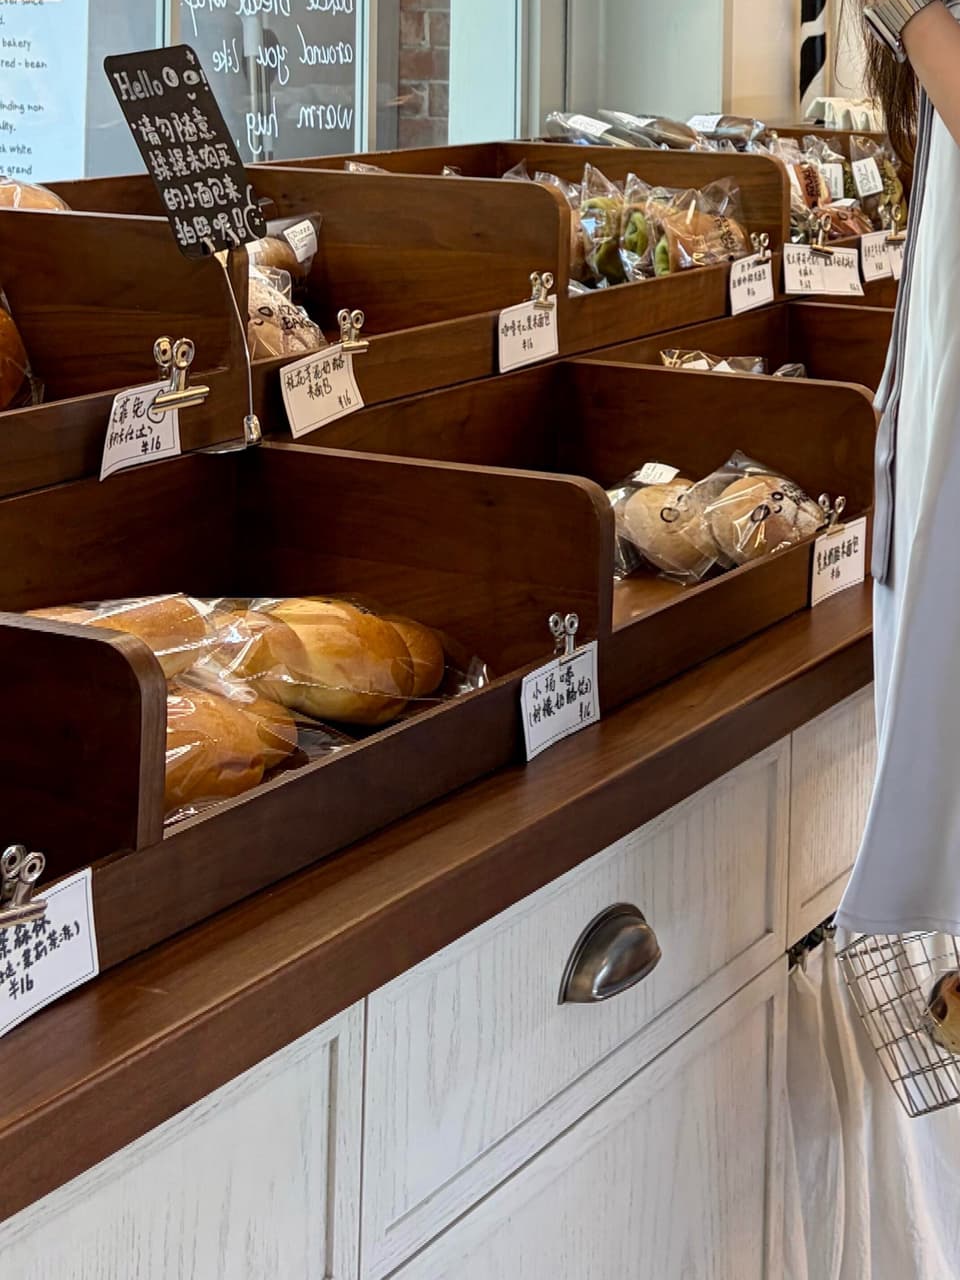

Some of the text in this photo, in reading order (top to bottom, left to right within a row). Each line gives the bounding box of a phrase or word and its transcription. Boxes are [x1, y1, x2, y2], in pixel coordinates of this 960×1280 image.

[2, 38, 31, 52] bakery
[114, 70, 164, 101] Hello
[137, 106, 216, 146] 请勿随意
[149, 142, 236, 181] 揉捏未购买
[163, 173, 241, 211] 的小面包来
[338, 388, 352, 409] ¥16
[141, 435, 161, 455] ¥16
[9, 973, 34, 1000] ¥16
